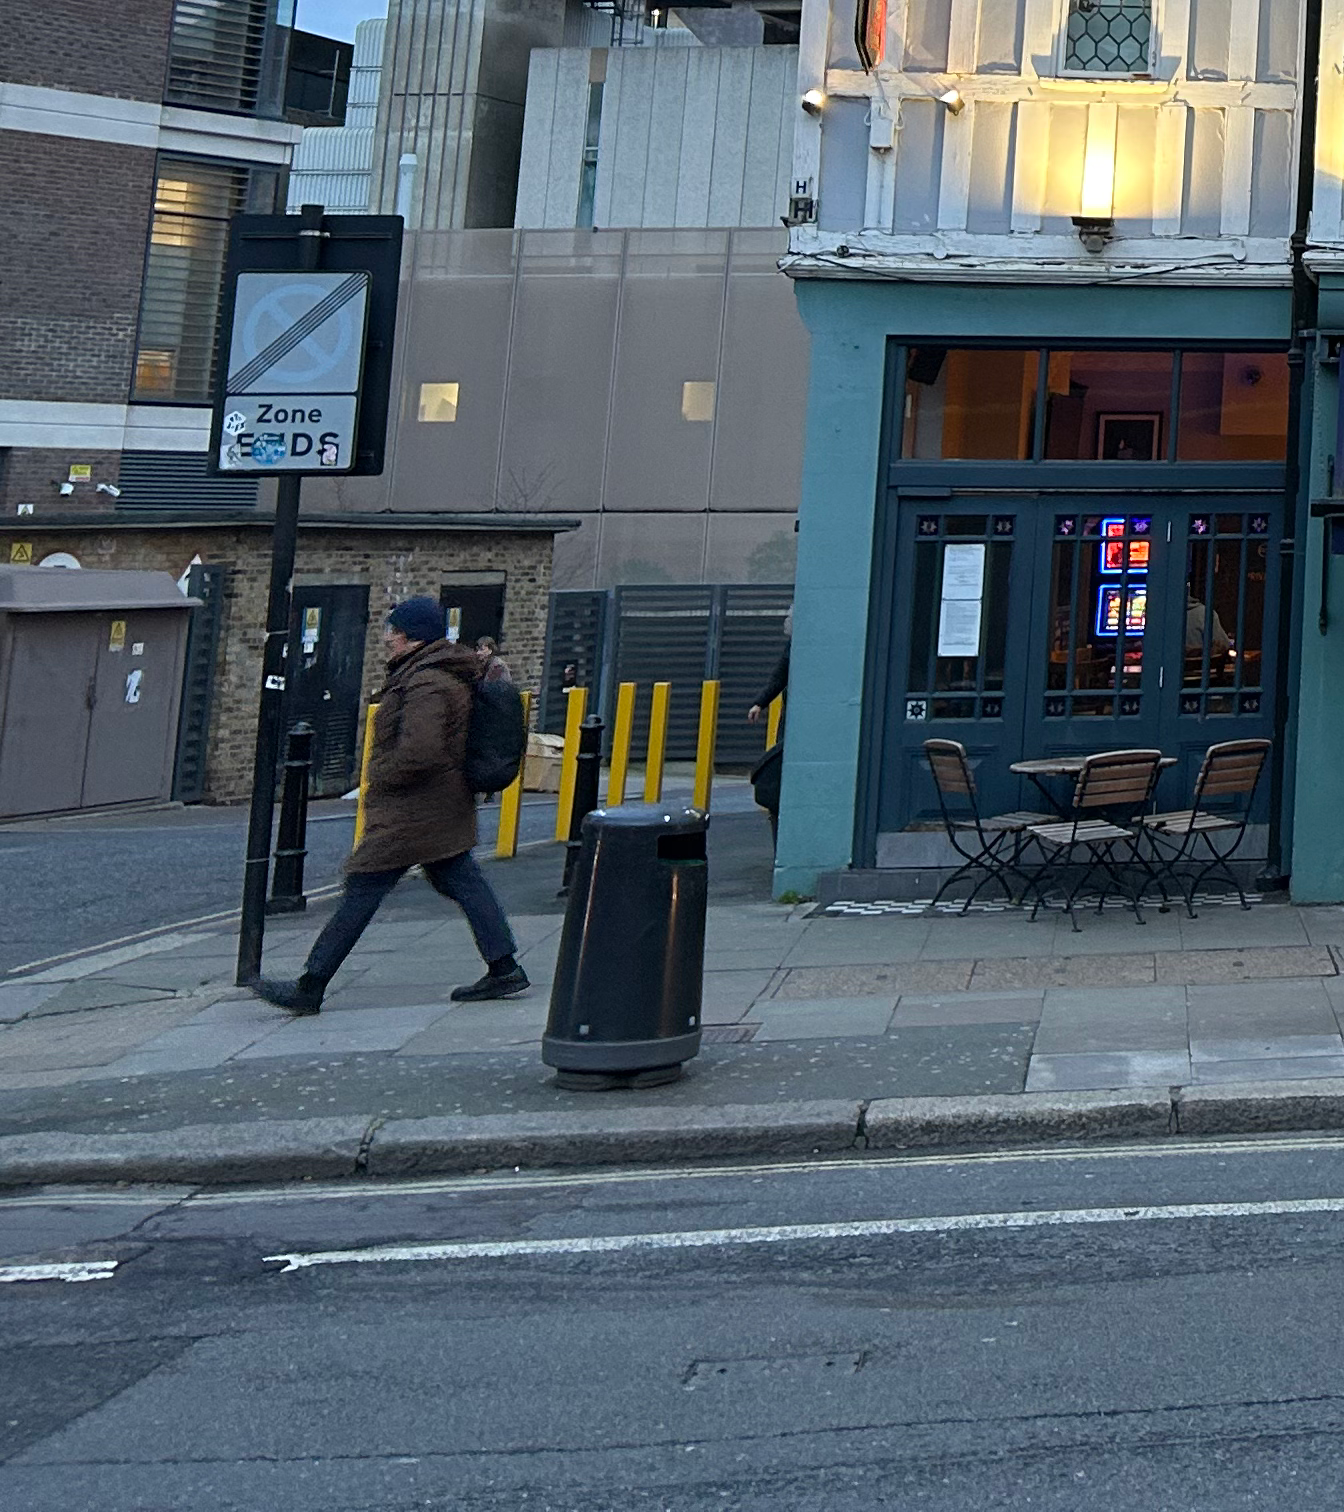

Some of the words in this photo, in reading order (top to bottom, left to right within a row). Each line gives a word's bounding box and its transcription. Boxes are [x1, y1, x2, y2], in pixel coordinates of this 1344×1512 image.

[796, 180, 806, 194] H
[256, 404, 322, 424] Zone
[237, 431, 340, 457] EDS
